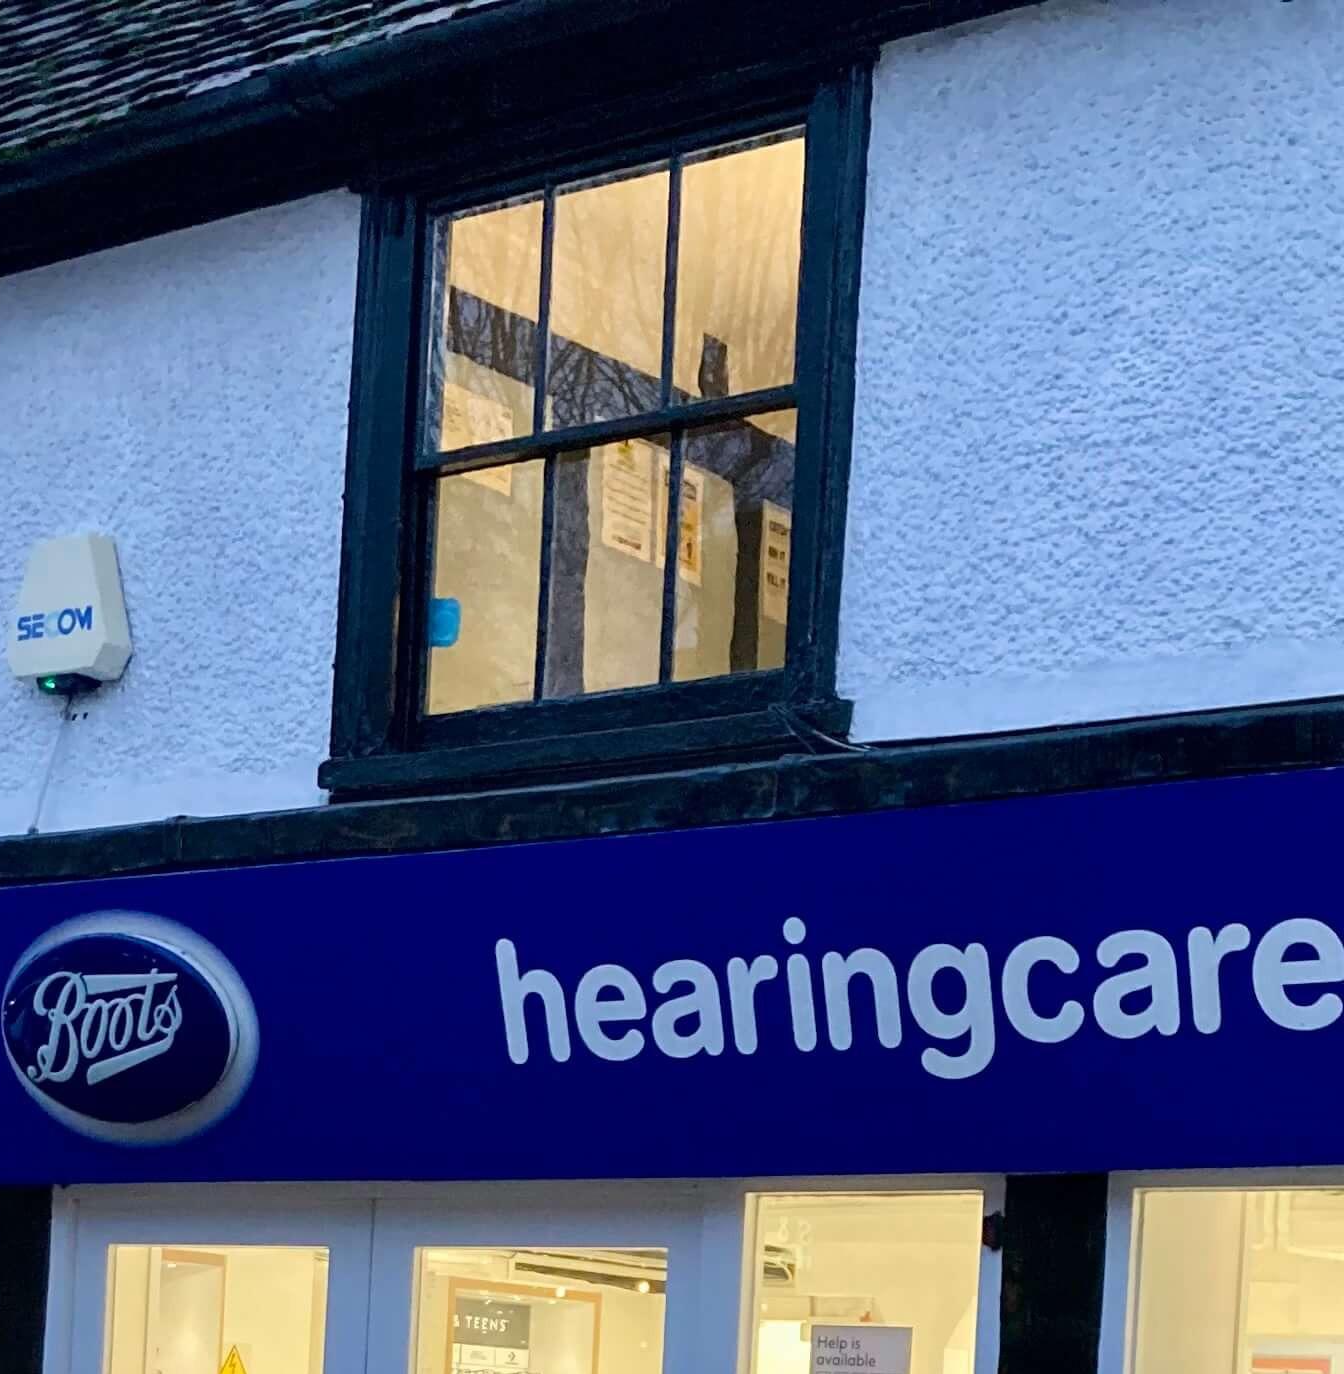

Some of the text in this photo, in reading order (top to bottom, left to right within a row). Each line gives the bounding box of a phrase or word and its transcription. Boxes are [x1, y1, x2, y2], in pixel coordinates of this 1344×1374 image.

[17, 605, 93, 642] SECOM
[27, 968, 183, 1086] Boots
[465, 1315, 508, 1334] TEENS
[817, 1336, 861, 1353] Help is
[816, 1352, 877, 1368] available
